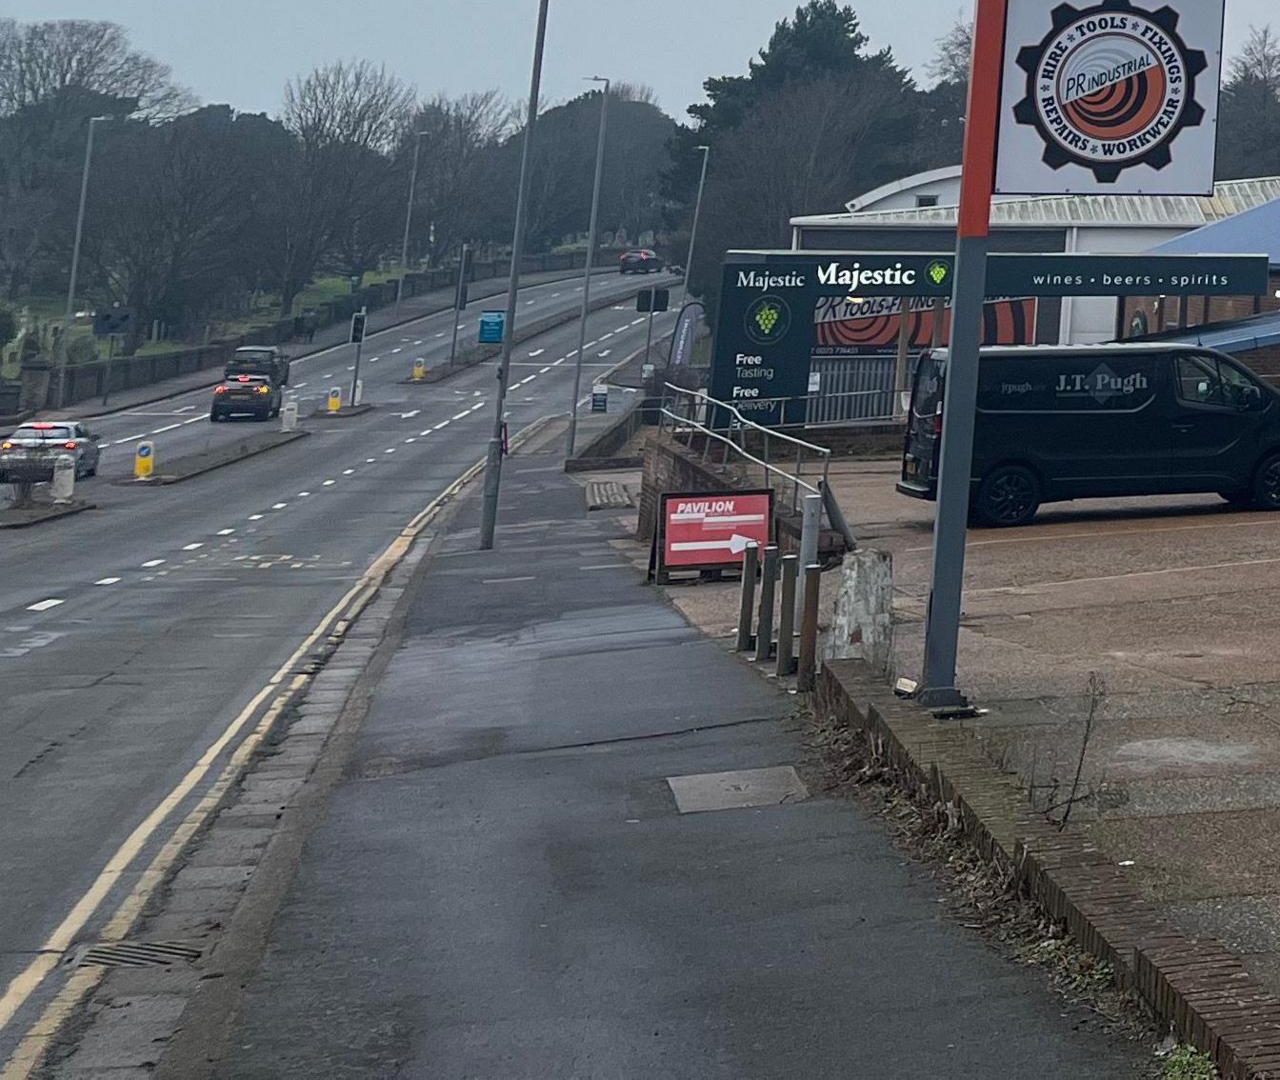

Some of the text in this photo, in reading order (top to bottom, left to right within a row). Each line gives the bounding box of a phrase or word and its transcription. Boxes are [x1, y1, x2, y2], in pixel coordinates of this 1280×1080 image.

[1041, 41, 1069, 80] HIRE
[1075, 16, 1182, 84] TOOLS FIXINGS
[1065, 54, 1152, 100] PR INDUSTRIAL
[1041, 95, 1180, 156] REPAIRS WORKWEAR
[737, 271, 805, 291] Majestic
[818, 263, 916, 291] Majestic
[1033, 274, 1229, 287] wines beers spirits
[735, 353, 762, 366] Free
[736, 367, 774, 381] Tasting
[1055, 372, 1148, 394] J.T. Pugh
[732, 386, 759, 398] Free
[677, 501, 735, 513] PAVILION
